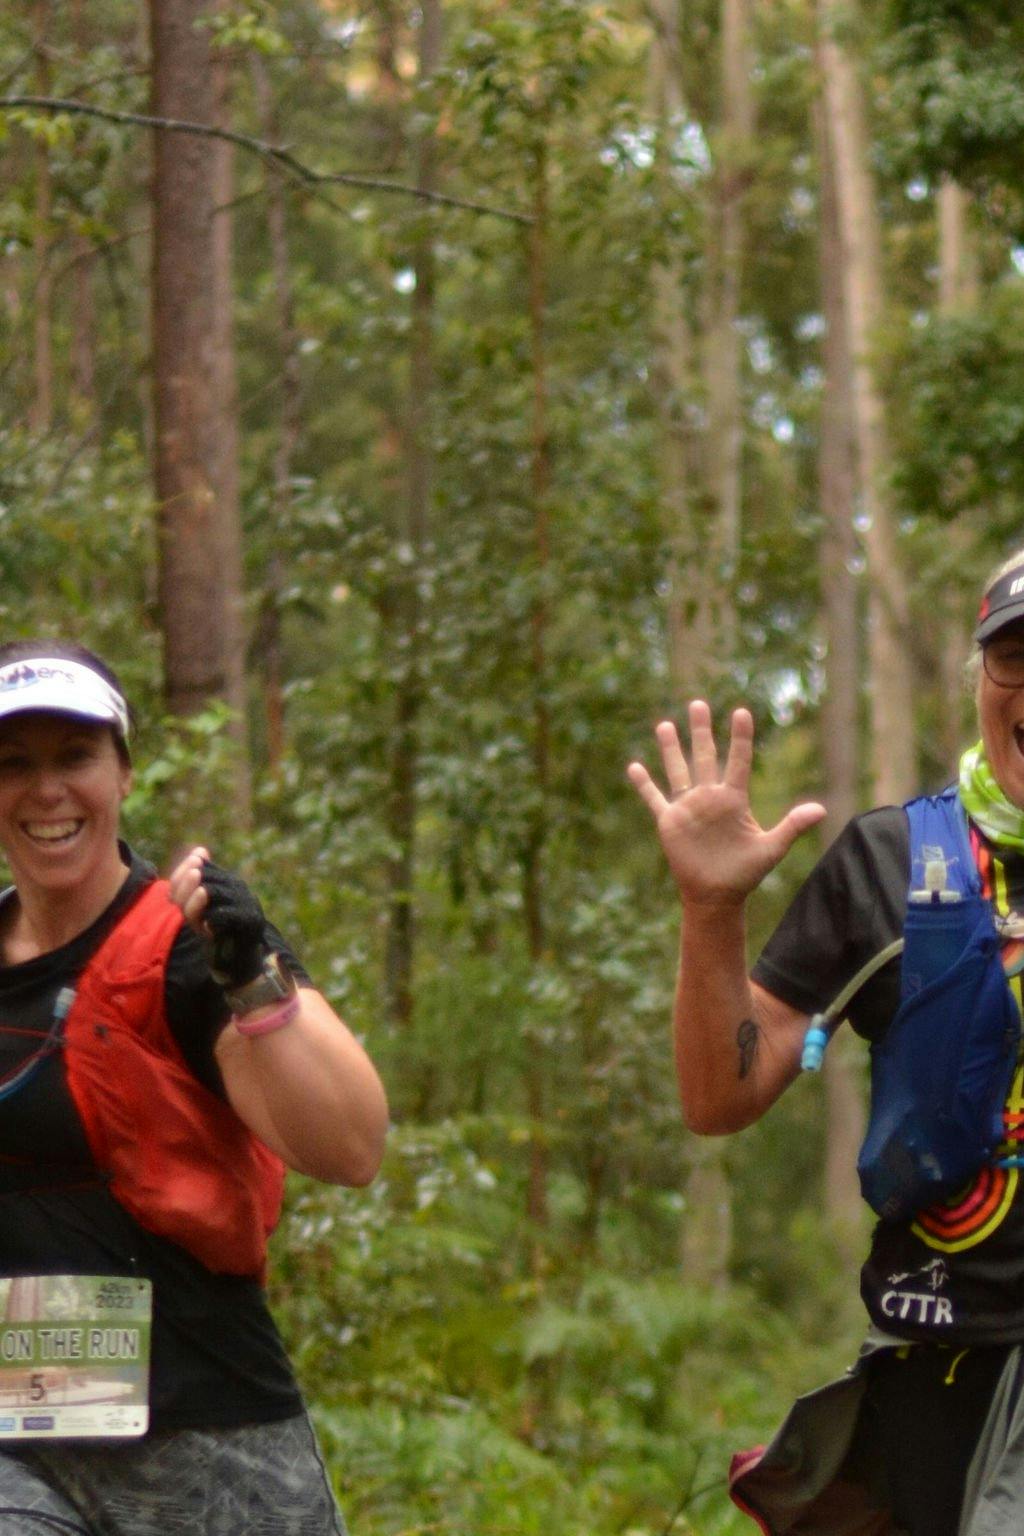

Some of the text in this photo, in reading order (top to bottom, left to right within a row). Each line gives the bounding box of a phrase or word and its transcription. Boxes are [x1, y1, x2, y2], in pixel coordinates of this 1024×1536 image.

[881, 1290, 953, 1324] CTTR
[2, 1328, 140, 1361] ON THE RUN
[30, 1374, 45, 1401] 5
